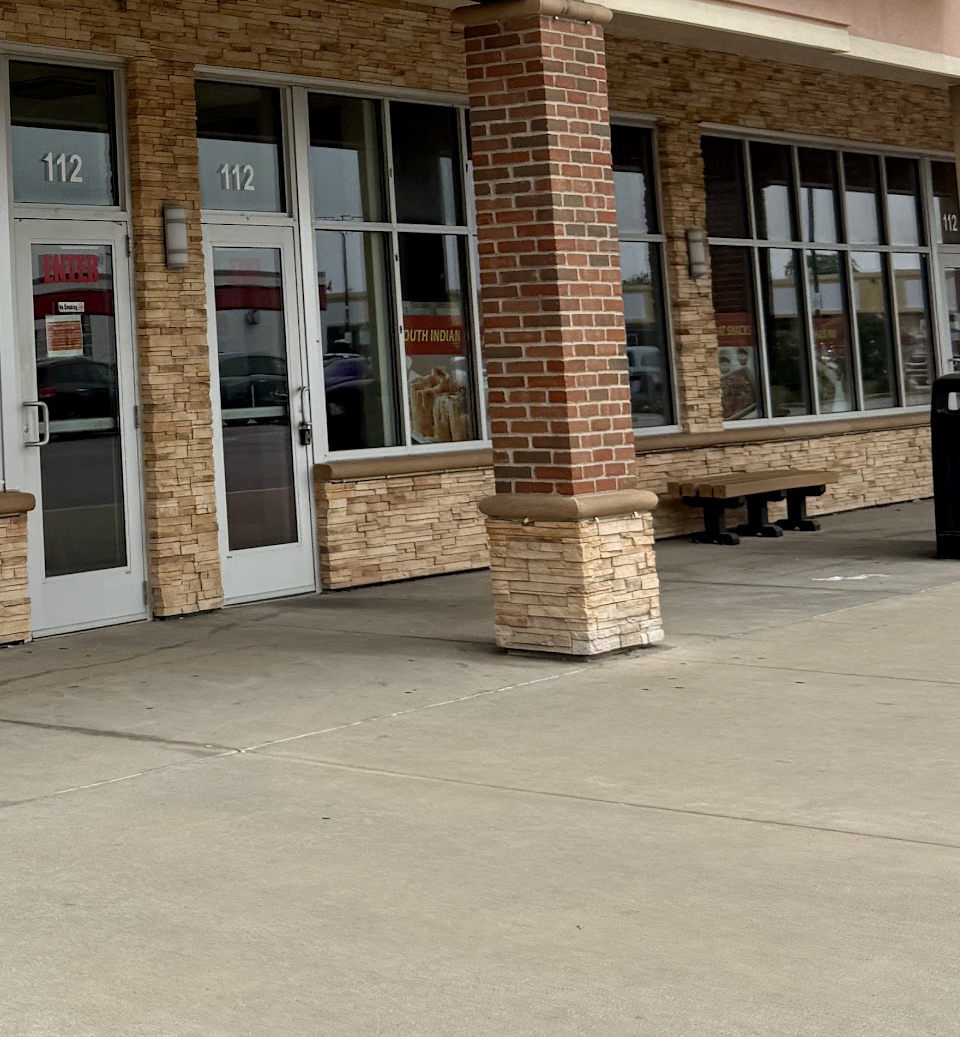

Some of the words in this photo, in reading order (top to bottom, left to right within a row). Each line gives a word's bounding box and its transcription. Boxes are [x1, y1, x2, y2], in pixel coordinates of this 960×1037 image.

[43, 152, 83, 182] 112
[221, 163, 255, 190] 112
[943, 214, 958, 231] 112
[42, 254, 99, 283] ENTER
[404, 329, 428, 342] OUTH
[431, 329, 460, 342] INDIAN
